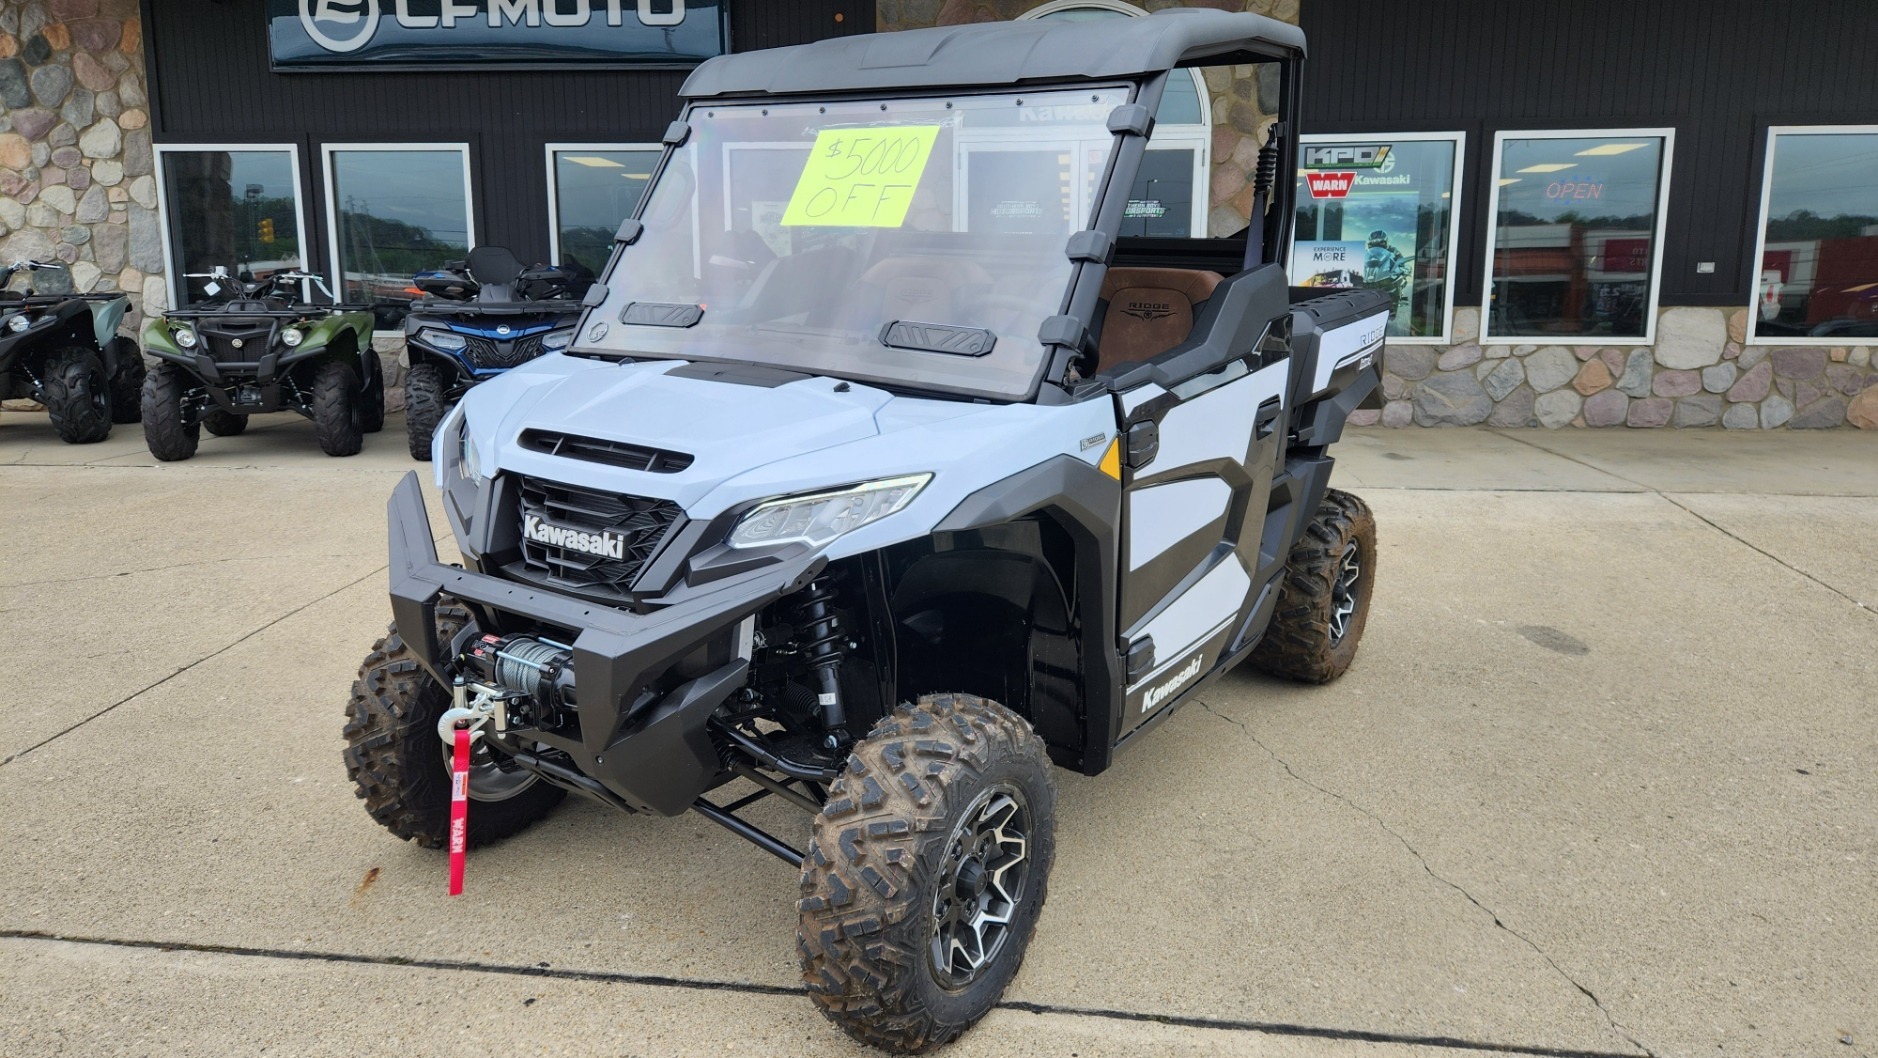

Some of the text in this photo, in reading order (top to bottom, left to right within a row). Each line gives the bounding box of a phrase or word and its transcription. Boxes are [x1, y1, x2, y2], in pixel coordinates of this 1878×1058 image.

[825, 136, 920, 180] $5000
[1312, 178, 1348, 191] WARN
[1354, 174, 1411, 186] Kawasaki
[1546, 182, 1603, 199] OPEN
[805, 184, 912, 221] OFF
[1313, 252, 1346, 261] MORE
[1128, 302, 1170, 310] RIDGE
[524, 514, 624, 559] Kawasaki
[1141, 653, 1203, 713] Kawasaki
[451, 817, 464, 854] WARN
